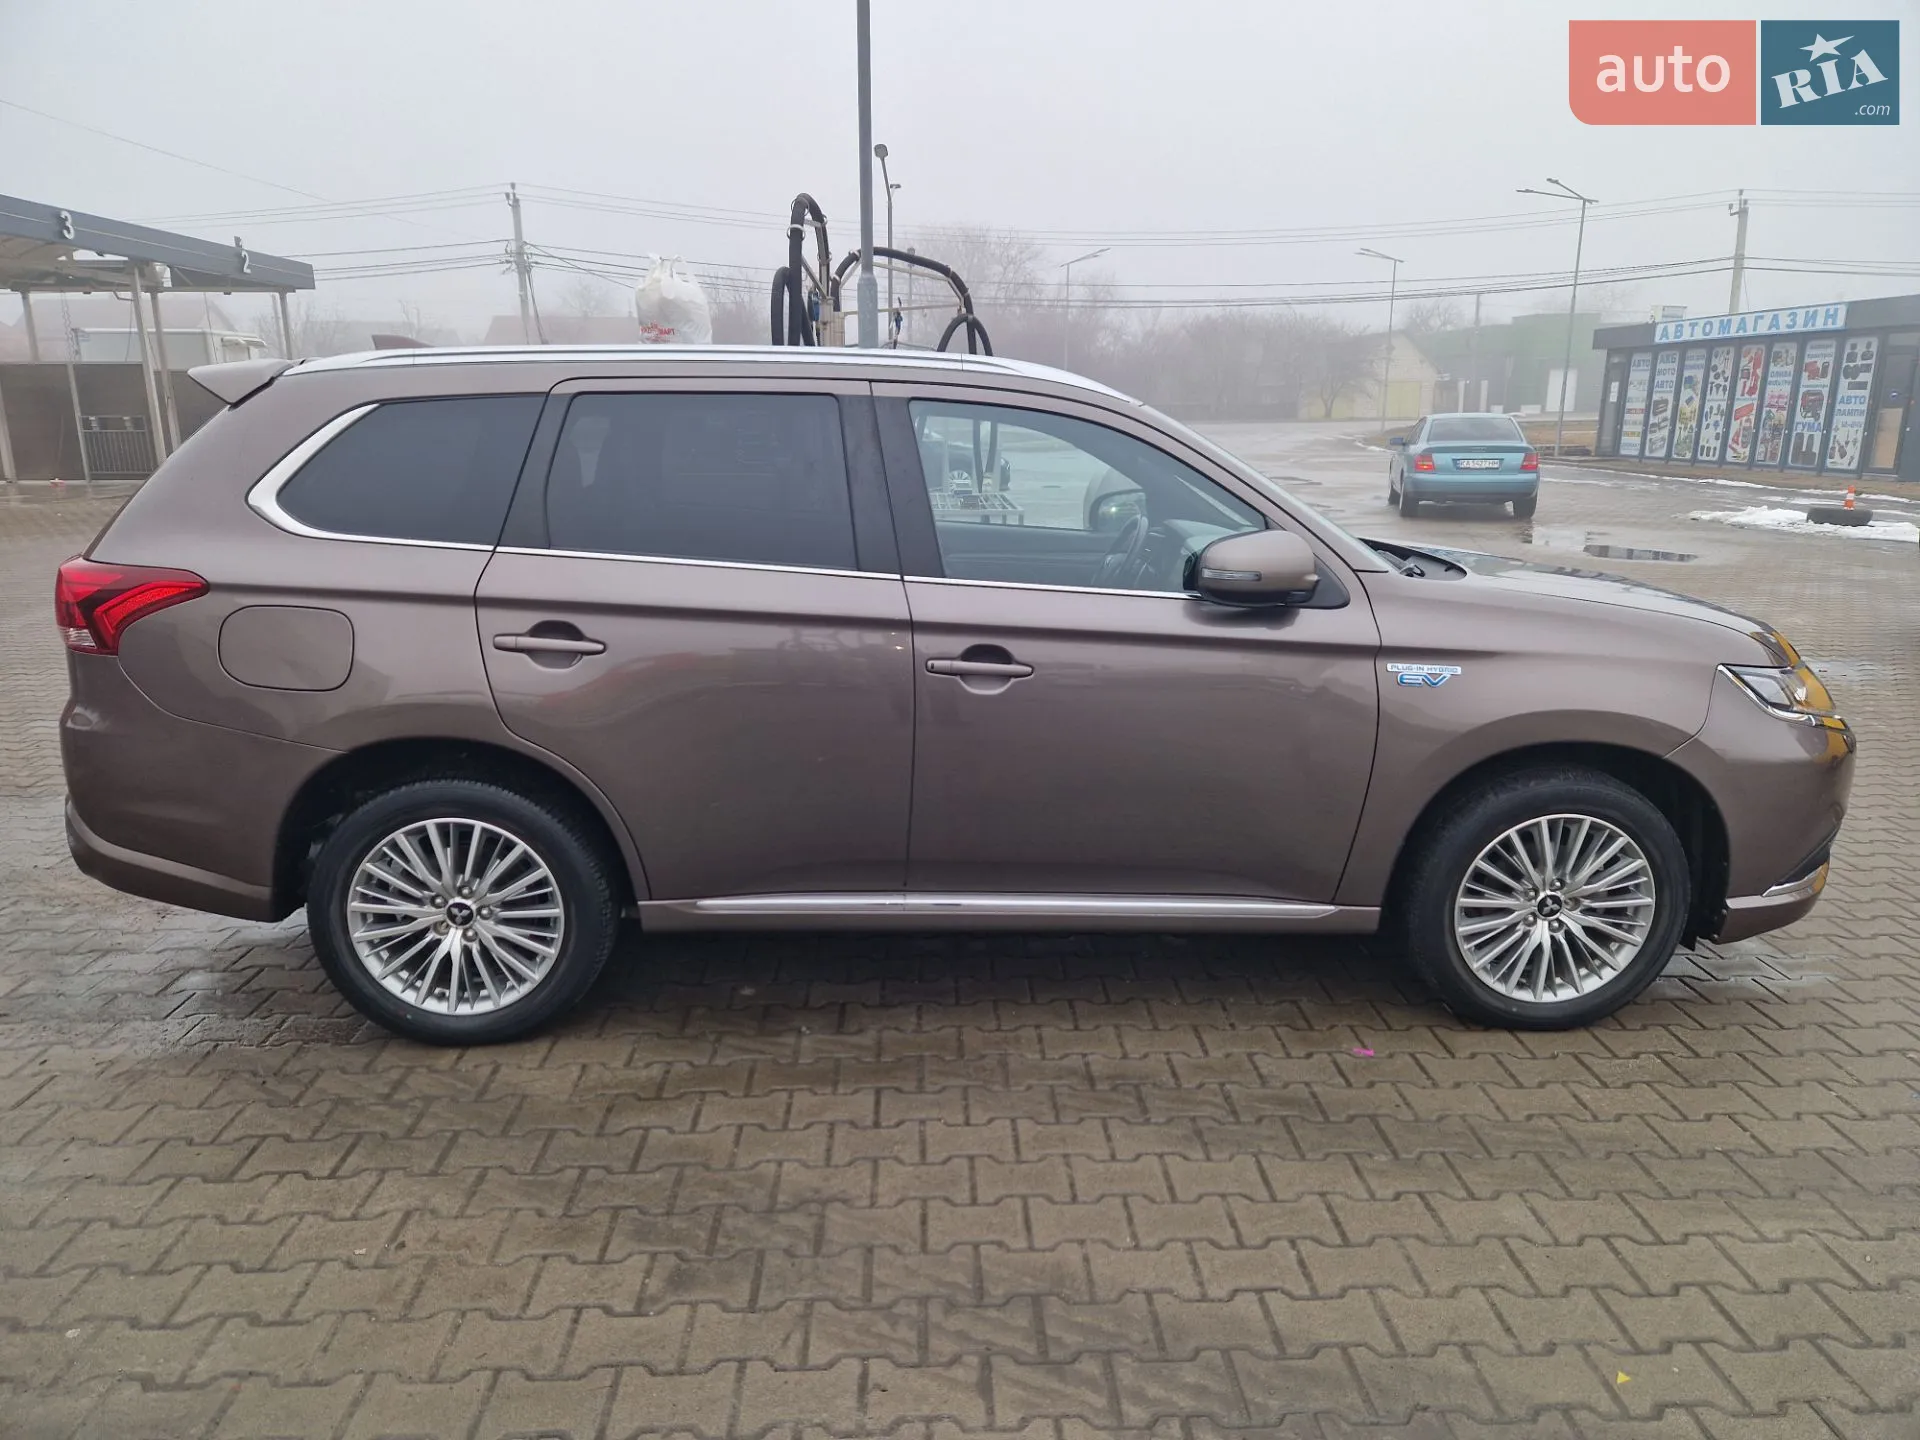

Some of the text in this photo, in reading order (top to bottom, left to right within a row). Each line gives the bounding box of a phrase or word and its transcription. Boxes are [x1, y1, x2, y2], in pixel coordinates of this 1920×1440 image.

[59, 210, 75, 240] 3
[1659, 307, 1840, 341] АВТОМАГАЗИН
[1838, 395, 1866, 405] АВТО
